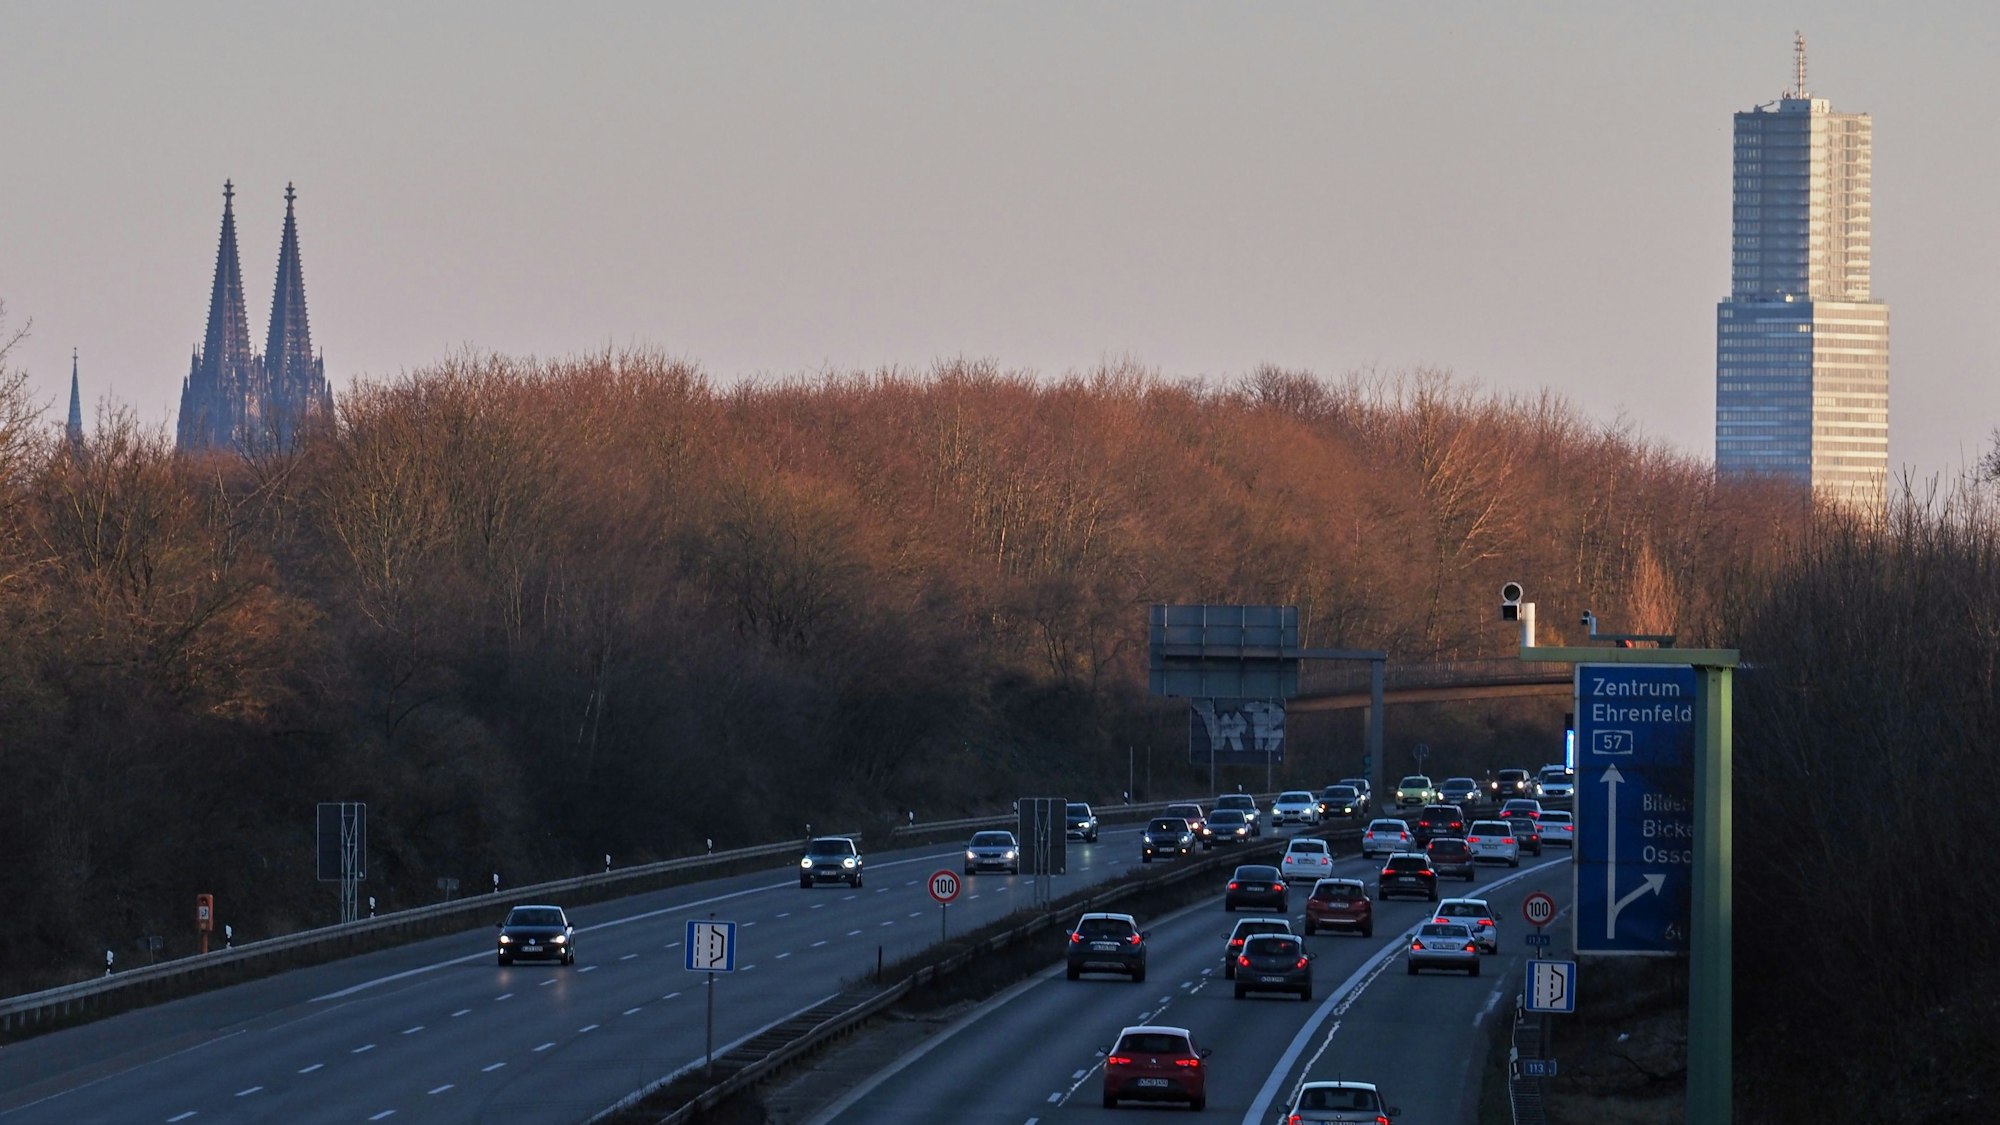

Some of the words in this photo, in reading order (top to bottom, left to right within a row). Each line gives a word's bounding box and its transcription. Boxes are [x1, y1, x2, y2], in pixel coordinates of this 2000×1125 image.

[1593, 678, 1680, 697] Zentrum
[1593, 703, 1692, 722] Ehrenfeld
[1603, 734, 1623, 750] 57
[935, 879, 955, 894] 100
[1529, 902, 1549, 917] 100
